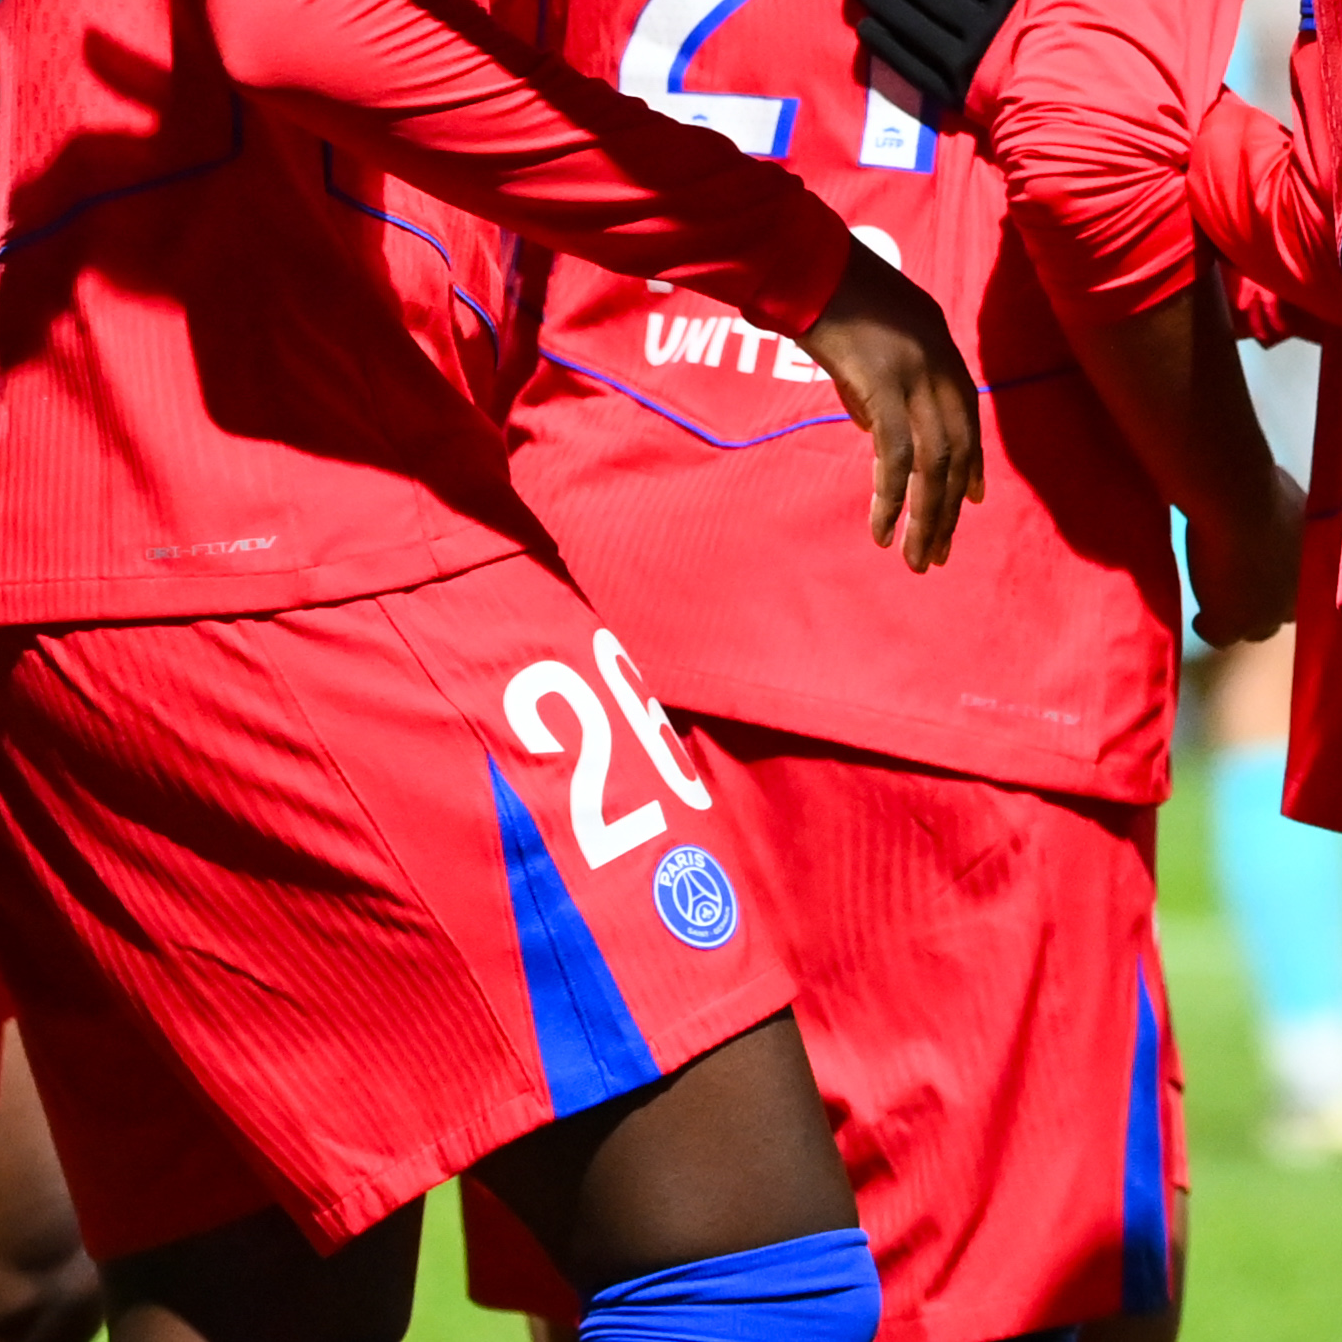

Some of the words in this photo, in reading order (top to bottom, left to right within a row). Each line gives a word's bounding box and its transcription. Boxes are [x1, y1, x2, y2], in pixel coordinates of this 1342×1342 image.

[644, 312, 835, 383] UNITE
[502, 627, 713, 870] 26
[659, 851, 707, 887] PARIS
